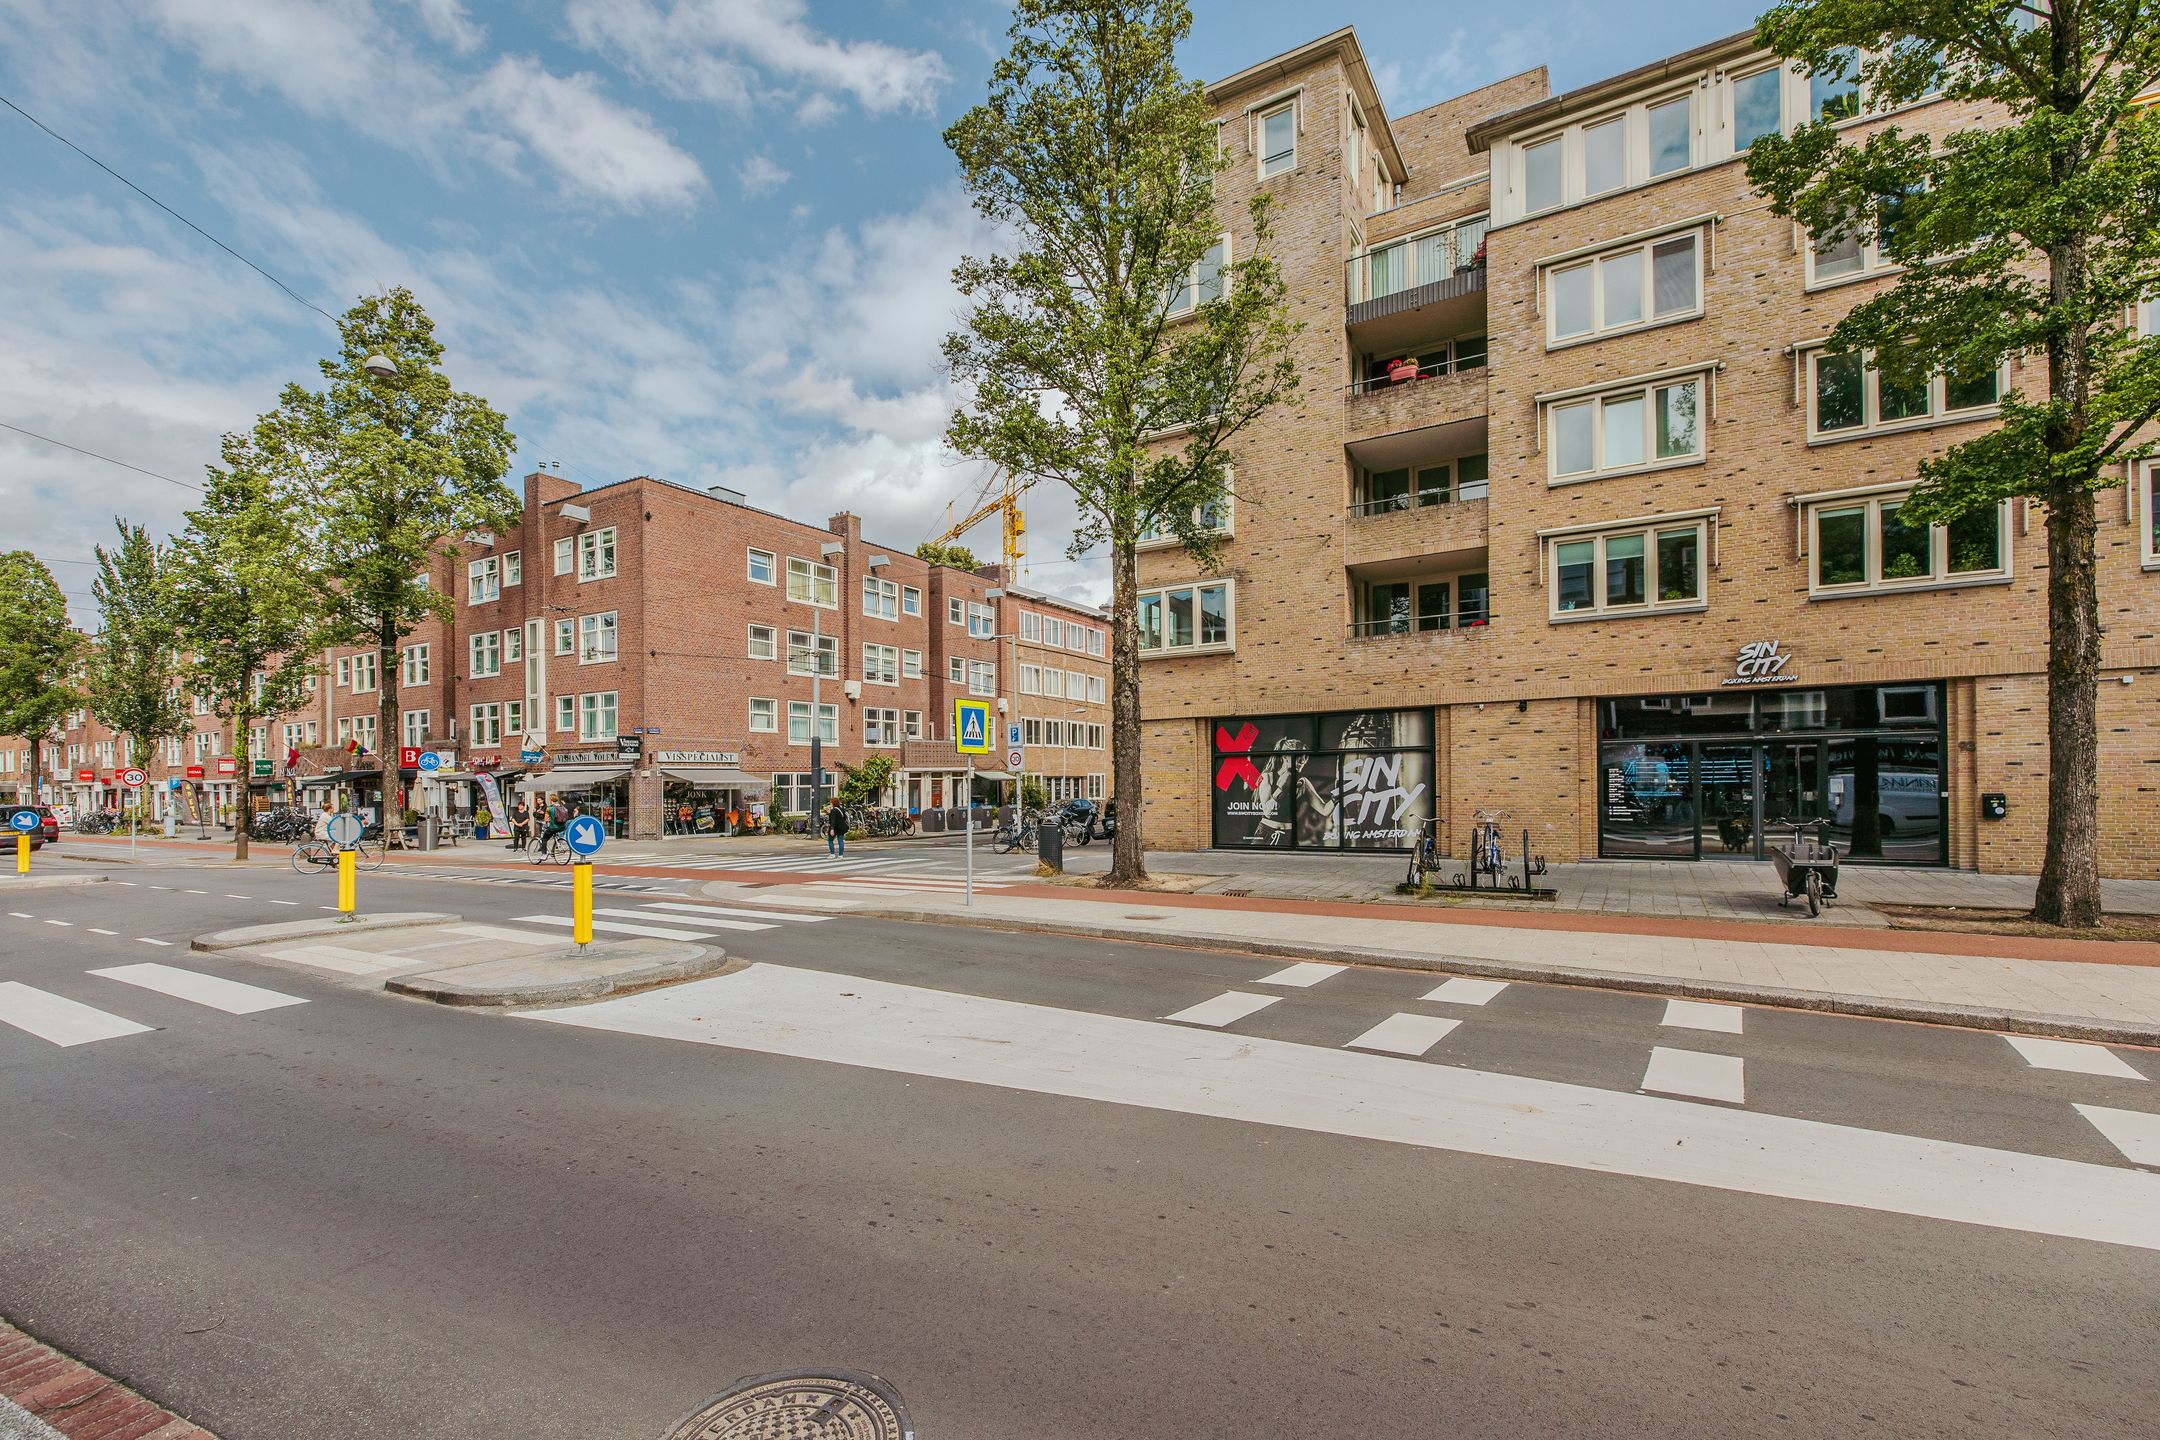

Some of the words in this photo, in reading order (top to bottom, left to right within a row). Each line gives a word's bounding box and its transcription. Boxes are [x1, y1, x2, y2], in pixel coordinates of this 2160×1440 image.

[1737, 640, 1779, 661] SIN
[1736, 653, 1792, 676] CITY
[1721, 677, 1751, 685] BOXING
[1752, 674, 1799, 683] AMSTERDAM
[405, 750, 416, 762] B
[665, 752, 734, 762] VISSPECIALIST
[126, 773, 142, 781] 30
[1330, 752, 1402, 798] SIN
[686, 790, 707, 798] JONK
[1227, 802, 1250, 811] JOIN
[1332, 783, 1426, 826] CITY
[1322, 830, 1361, 840] BOING
